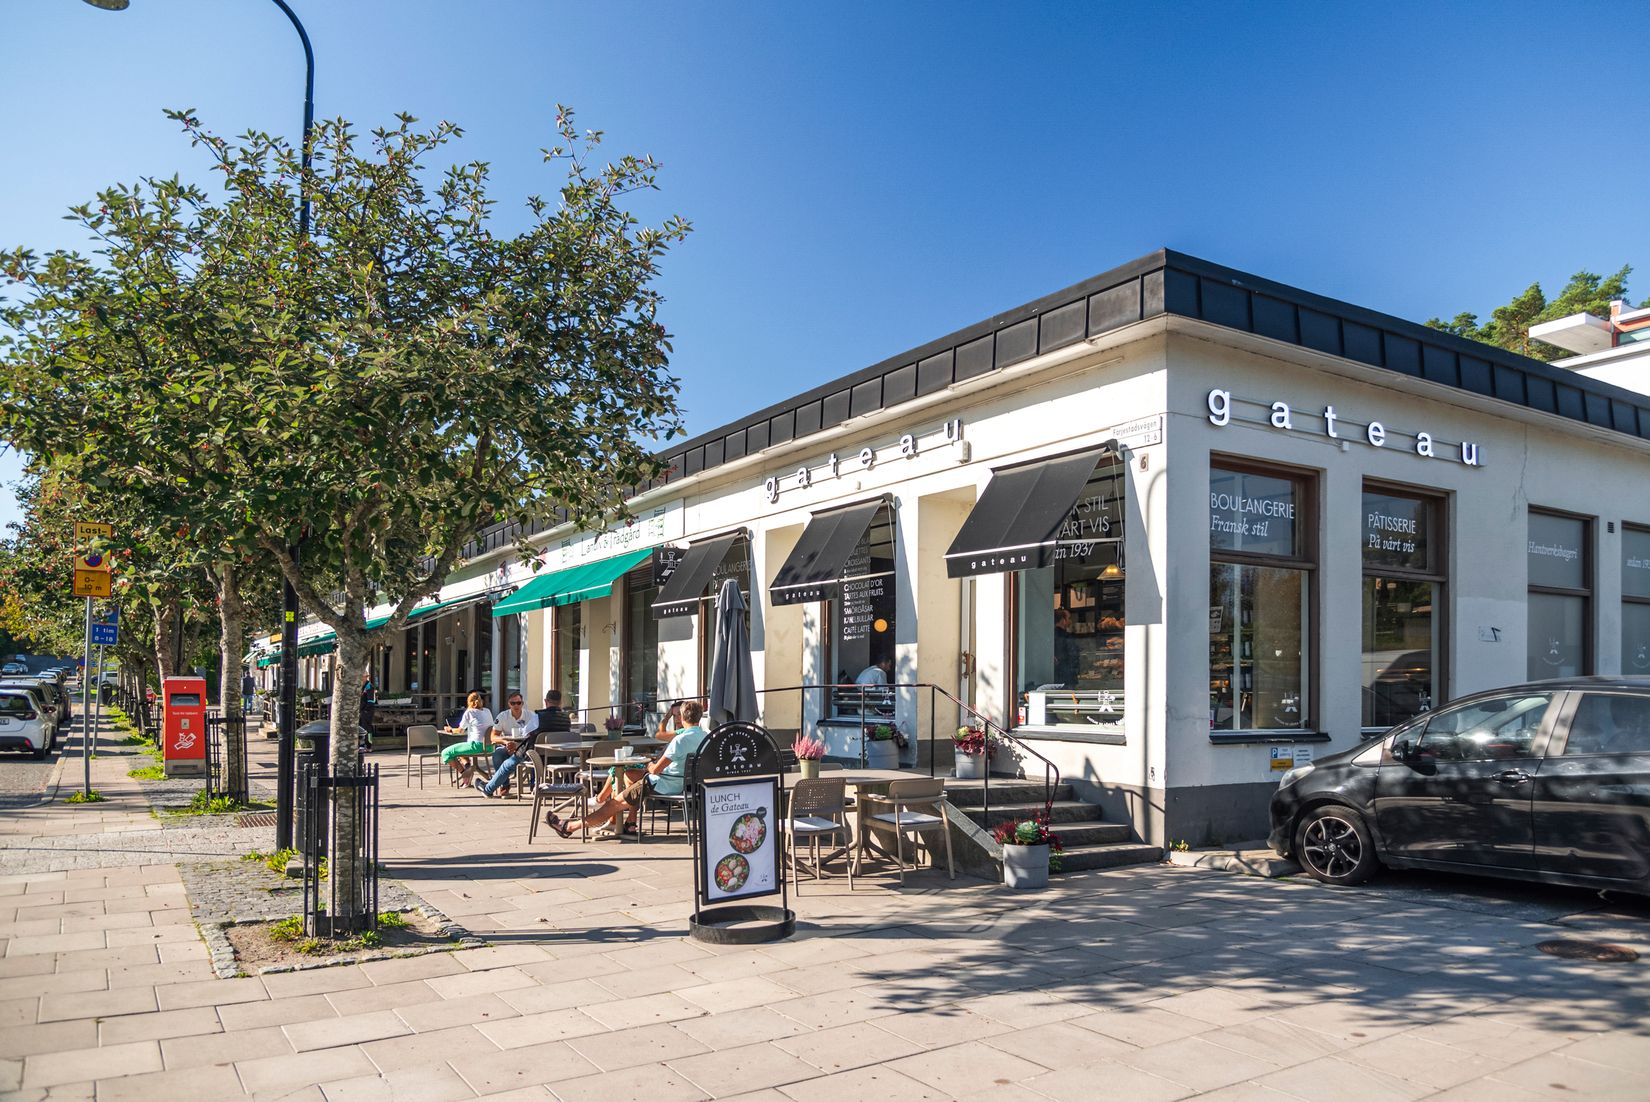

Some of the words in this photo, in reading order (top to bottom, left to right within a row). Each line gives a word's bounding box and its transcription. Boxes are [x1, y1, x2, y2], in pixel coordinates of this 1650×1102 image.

[1207, 388, 1478, 466] gateau
[765, 419, 961, 502] gateau
[1140, 456, 1147, 470] 6
[1083, 495, 1109, 513] STIL
[1210, 492, 1295, 519] BOULANGERIE
[80, 526, 107, 534] Last-
[1089, 515, 1110, 533] VIS
[1210, 515, 1249, 535] Fransk
[1251, 521, 1269, 537] stil
[1368, 511, 1416, 534] PÂTISSERIE
[1069, 542, 1096, 558] 1937
[1368, 533, 1380, 549] På
[1382, 536, 1401, 551] vårt
[1402, 540, 1415, 552] vis
[970, 554, 1027, 569] gateau
[785, 587, 820, 600] gateau
[844, 581, 870, 592] CHOCOLAT
[857, 625, 870, 633] LATTE
[715, 762, 761, 772] gateau
[710, 793, 740, 804] LUNCH
[711, 805, 720, 813] de
[721, 803, 749, 812] Gateau
